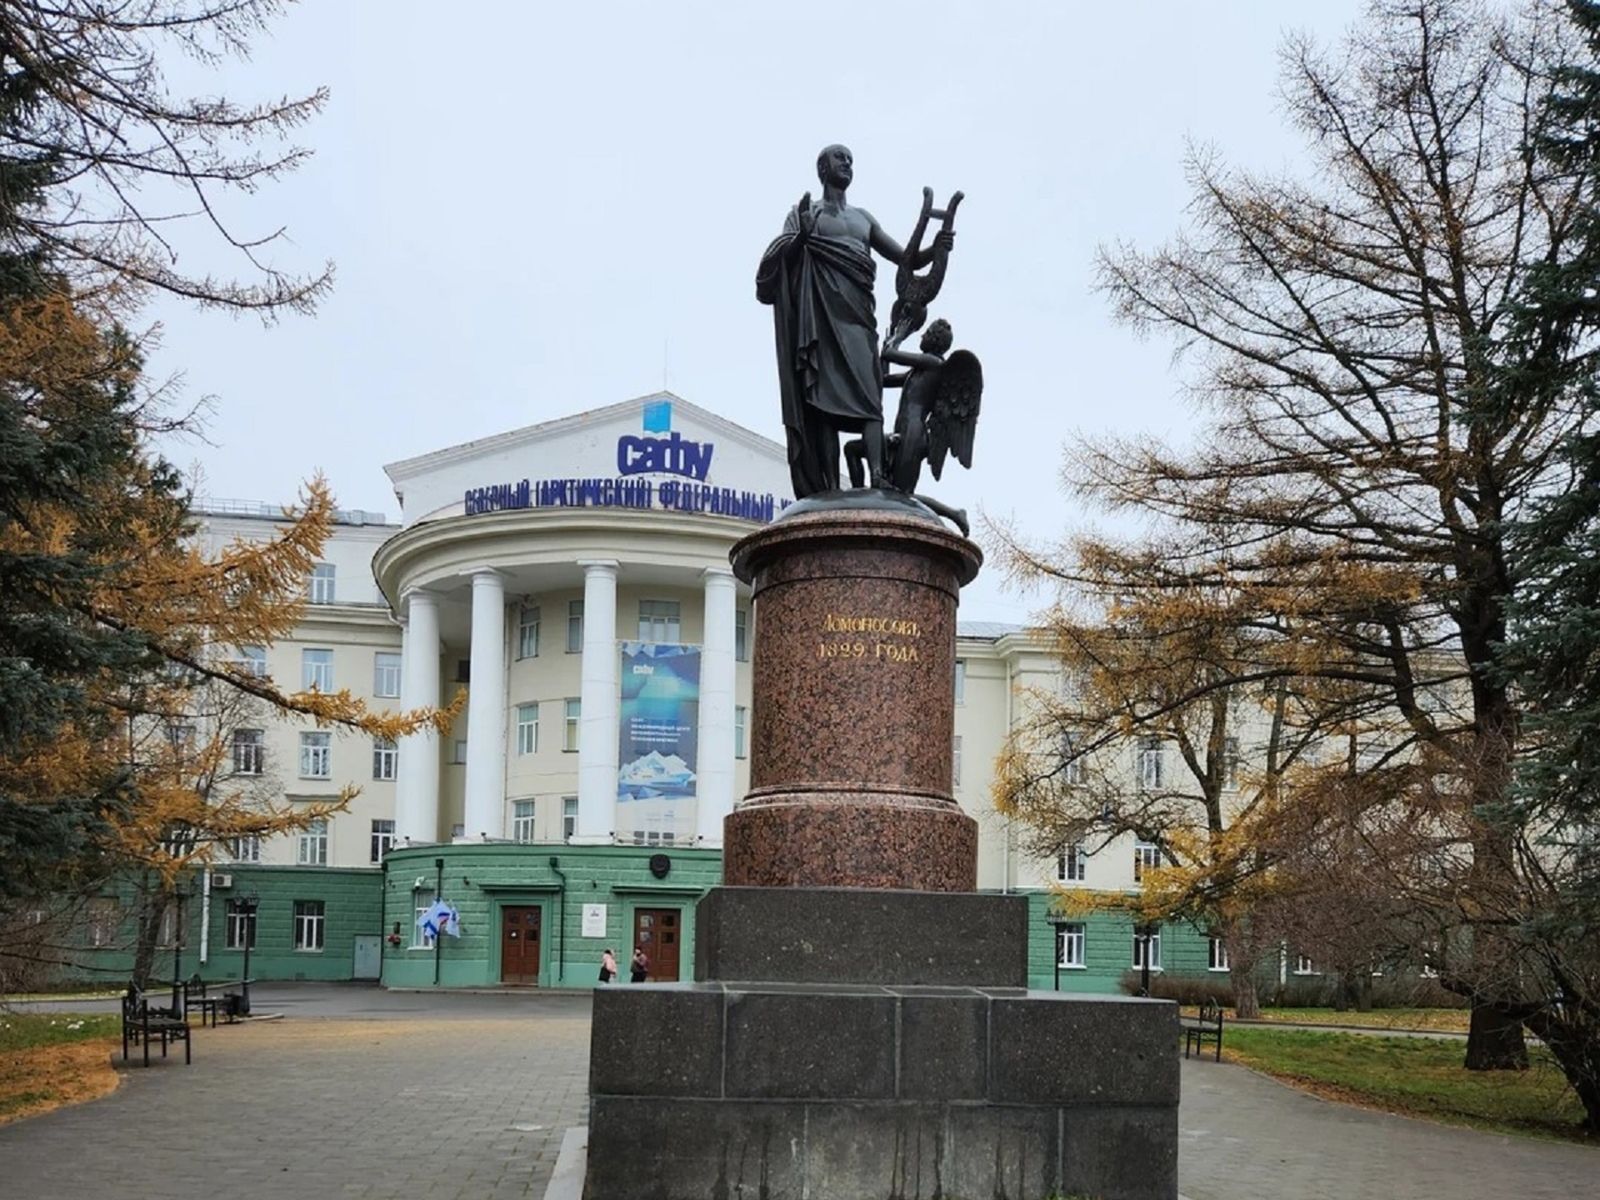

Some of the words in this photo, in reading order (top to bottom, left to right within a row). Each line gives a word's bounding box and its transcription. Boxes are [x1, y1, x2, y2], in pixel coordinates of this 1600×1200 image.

[658, 480, 774, 523] ФЕДЕРАЛЬНЫЙ
[817, 643, 865, 658] 1829
[876, 643, 919, 662] ГОДА
